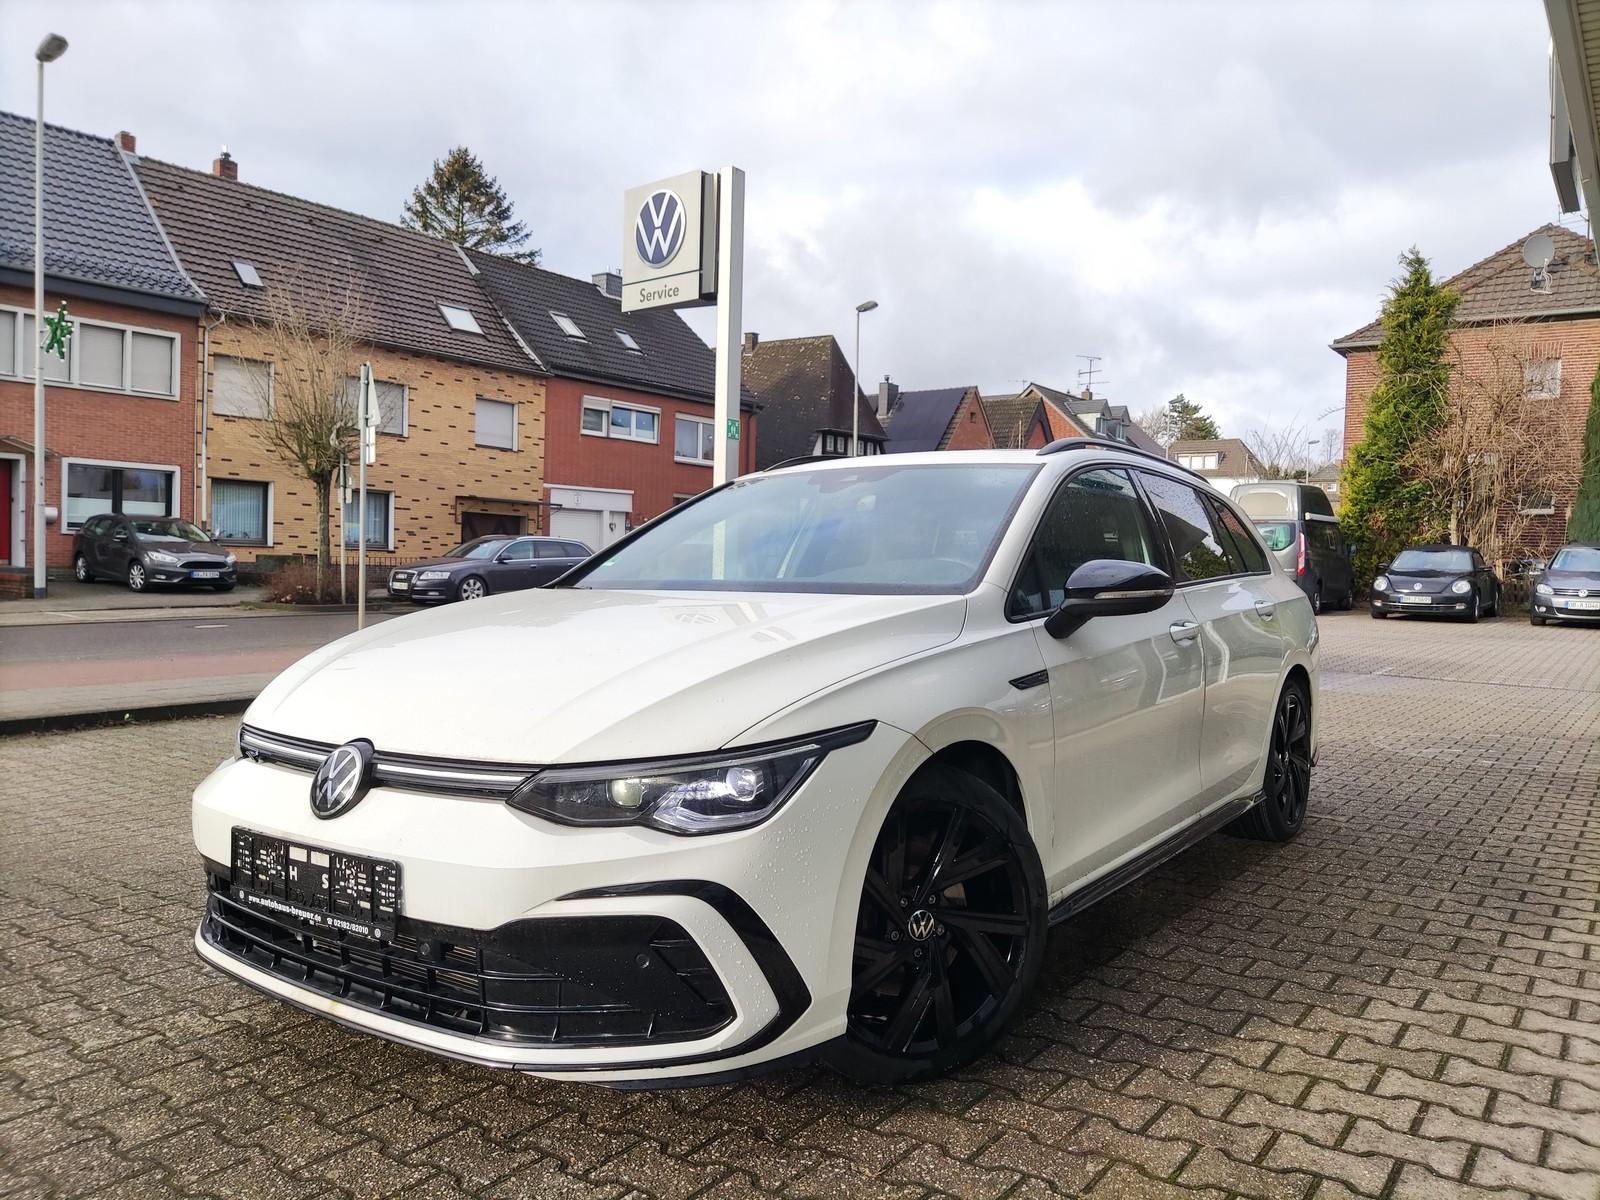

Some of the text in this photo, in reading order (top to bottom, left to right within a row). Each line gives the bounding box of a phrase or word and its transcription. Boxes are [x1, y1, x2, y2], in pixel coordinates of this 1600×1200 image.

[635, 189, 686, 268] VW
[639, 284, 680, 303] Service
[310, 745, 363, 819] VW
